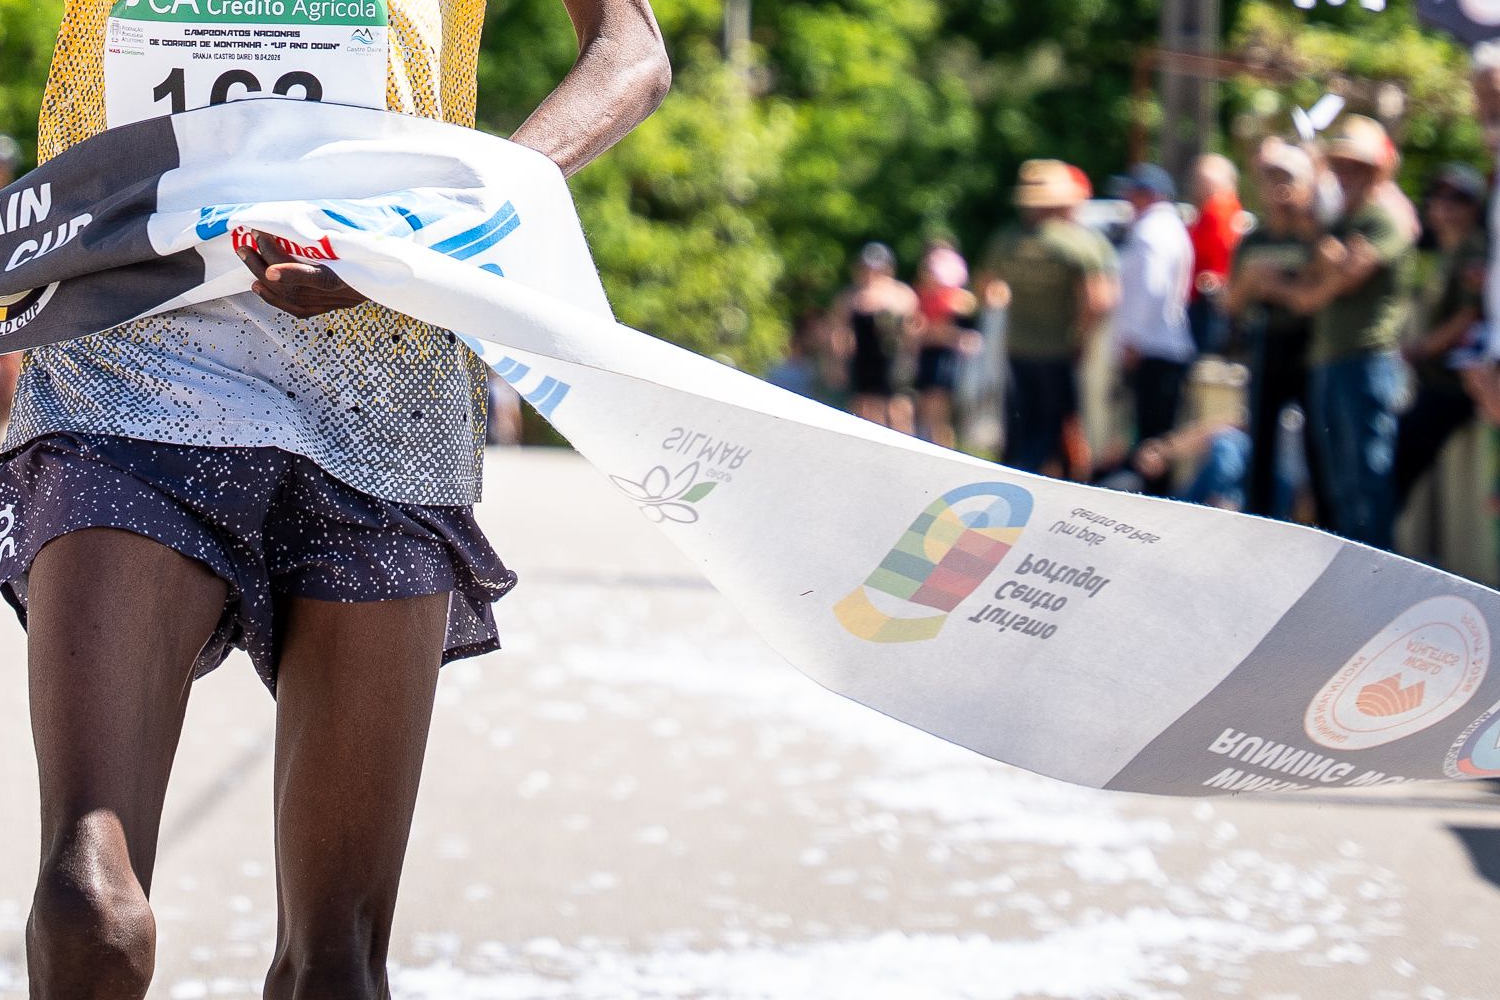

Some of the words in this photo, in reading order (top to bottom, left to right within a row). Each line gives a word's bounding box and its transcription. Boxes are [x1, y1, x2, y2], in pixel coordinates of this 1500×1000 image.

[184, 28, 250, 37] CAMPEONATOS
[253, 30, 301, 38] NACIONAIS
[149, 38, 160, 46] DE
[162, 39, 197, 47] CORRIDA
[199, 40, 211, 48] DE
[213, 41, 262, 49] MONTANHA
[289, 42, 308, 50] AND
[192, 52, 213, 60] GRANJA
[236, 53, 253, 61] DAIRE)
[15, 300, 40, 329] CUP
